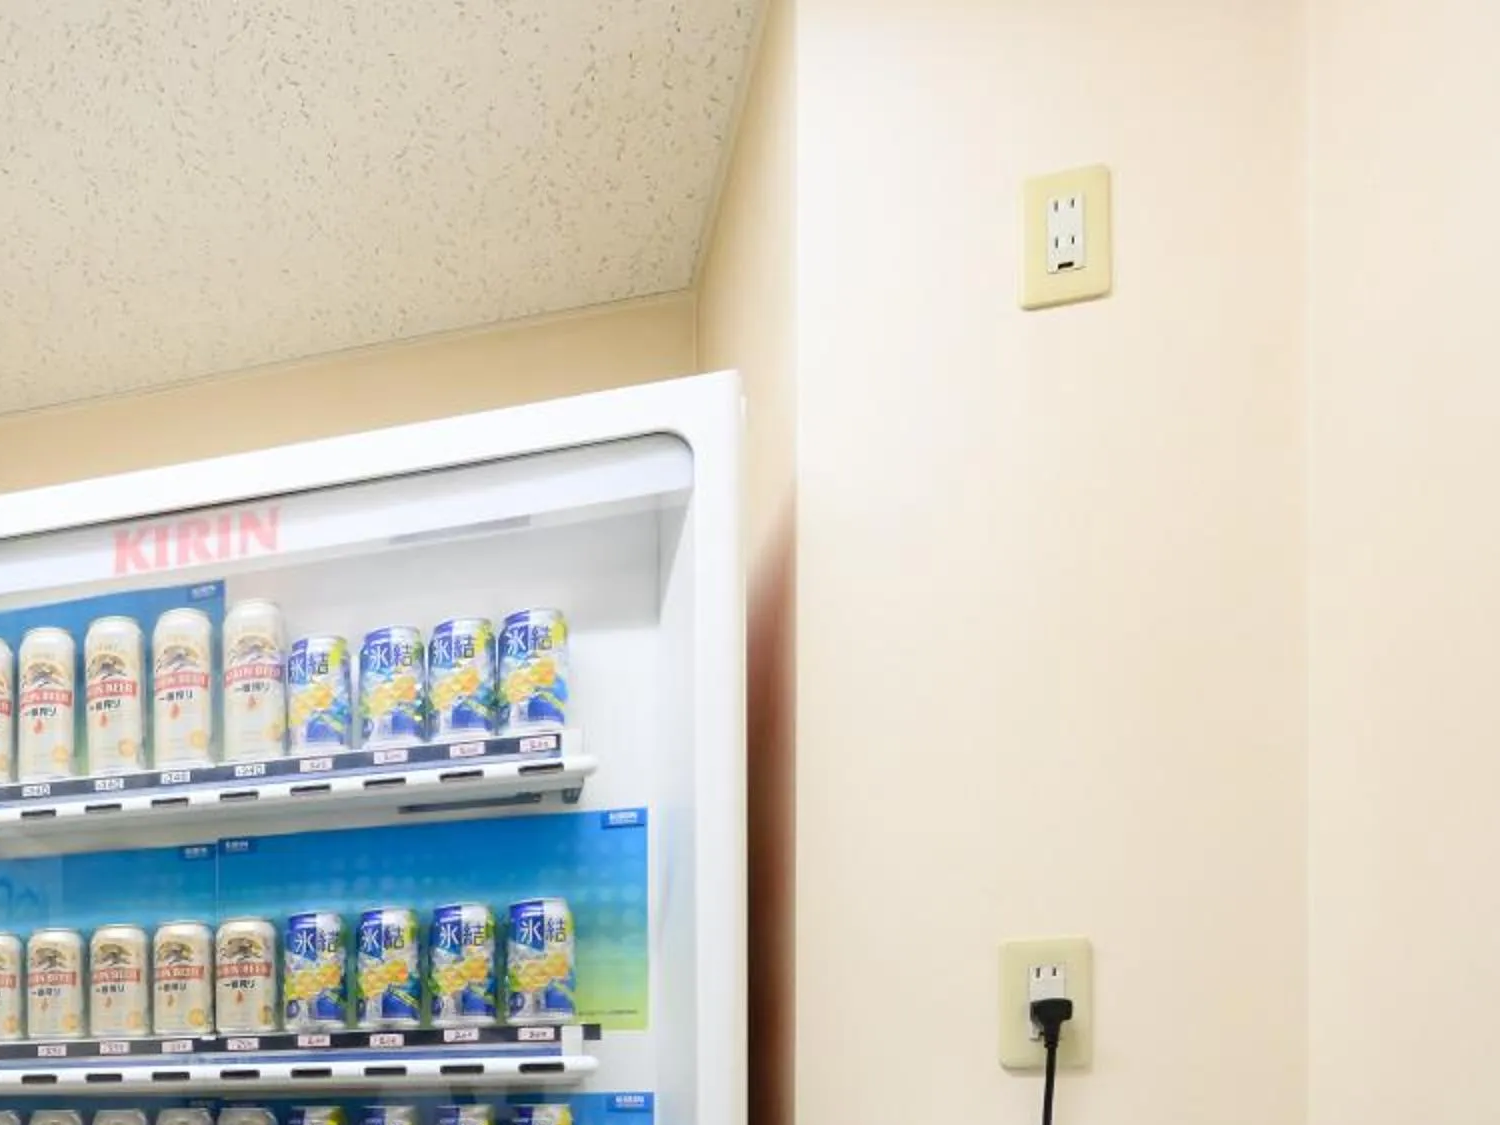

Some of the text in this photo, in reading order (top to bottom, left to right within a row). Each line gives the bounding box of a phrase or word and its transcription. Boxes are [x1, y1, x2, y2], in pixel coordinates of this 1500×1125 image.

[112, 506, 280, 574] KIRIN
[294, 928, 337, 953] 氷結
[362, 925, 405, 950] 氷結
[439, 922, 485, 948] 氷結
[520, 918, 566, 944] 氷結
